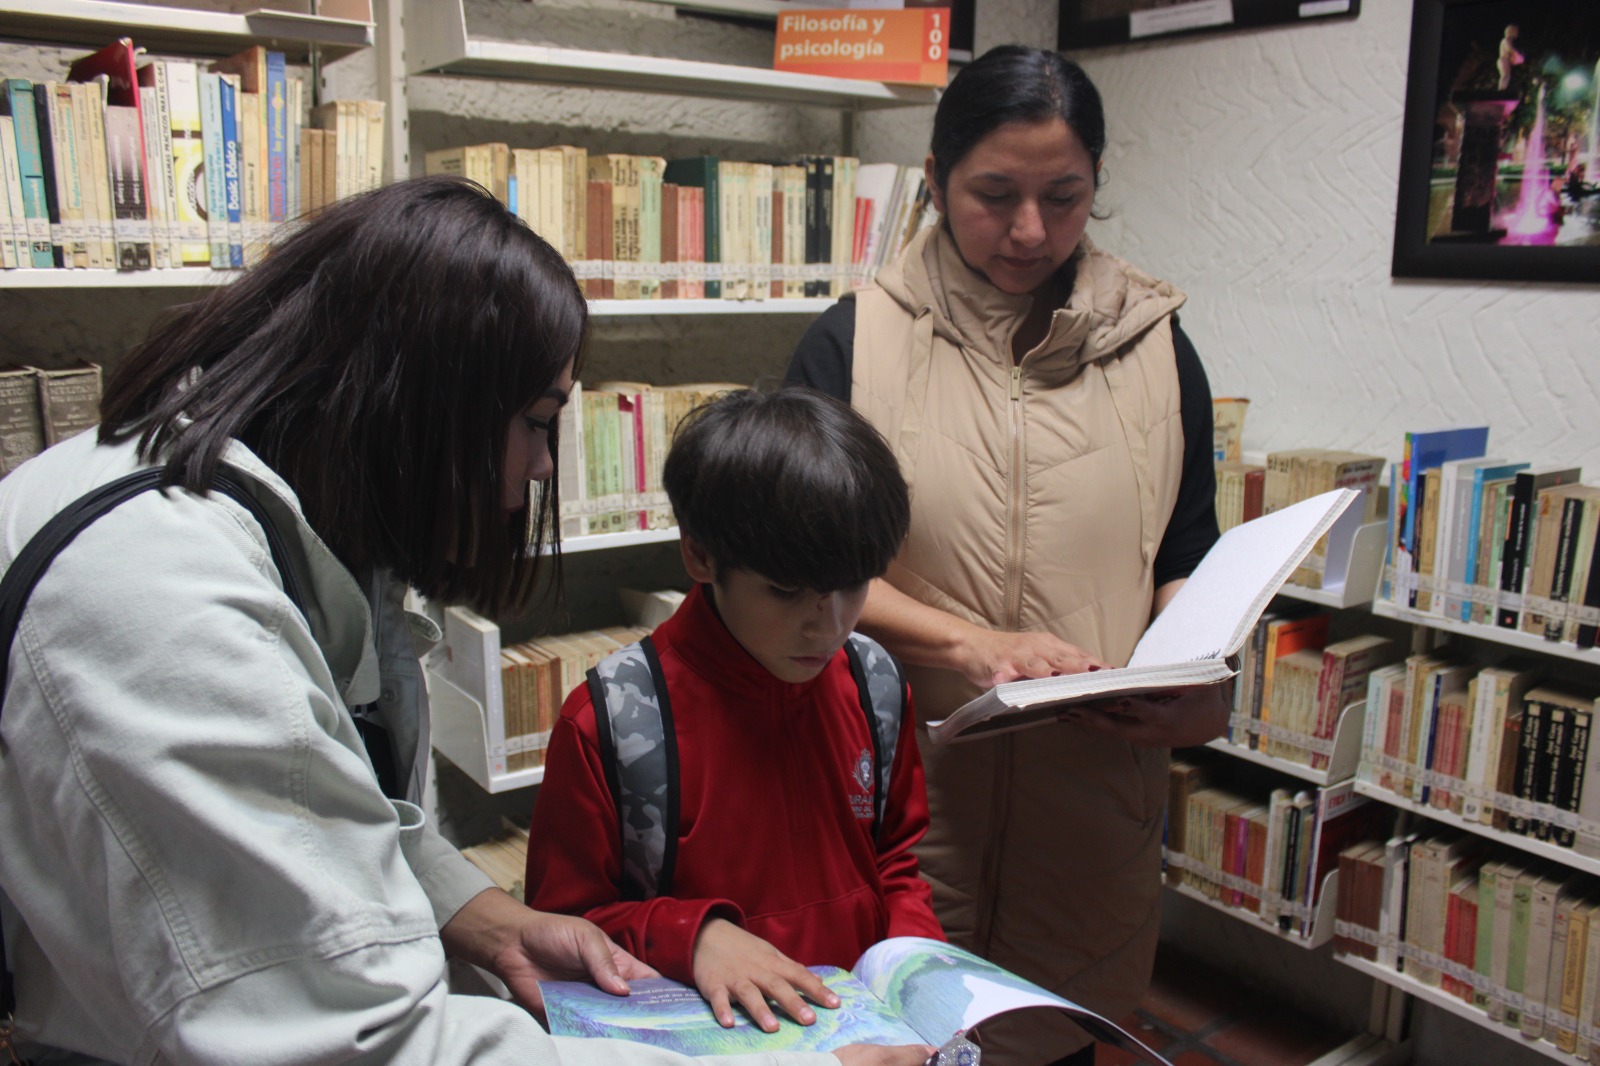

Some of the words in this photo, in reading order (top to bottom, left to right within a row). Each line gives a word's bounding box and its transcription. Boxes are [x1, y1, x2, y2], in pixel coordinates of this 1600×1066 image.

[782, 14, 867, 33] Filosofía
[872, 17, 885, 35] y
[780, 38, 884, 61] psicología
[160, 95, 168, 112] PARA
[161, 114, 171, 151] PRACTICOS
[225, 140, 238, 178] Básico
[164, 153, 175, 198] PROGRAMAS
[228, 179, 240, 210] Basic
[1556, 724, 1564, 745] mundo
